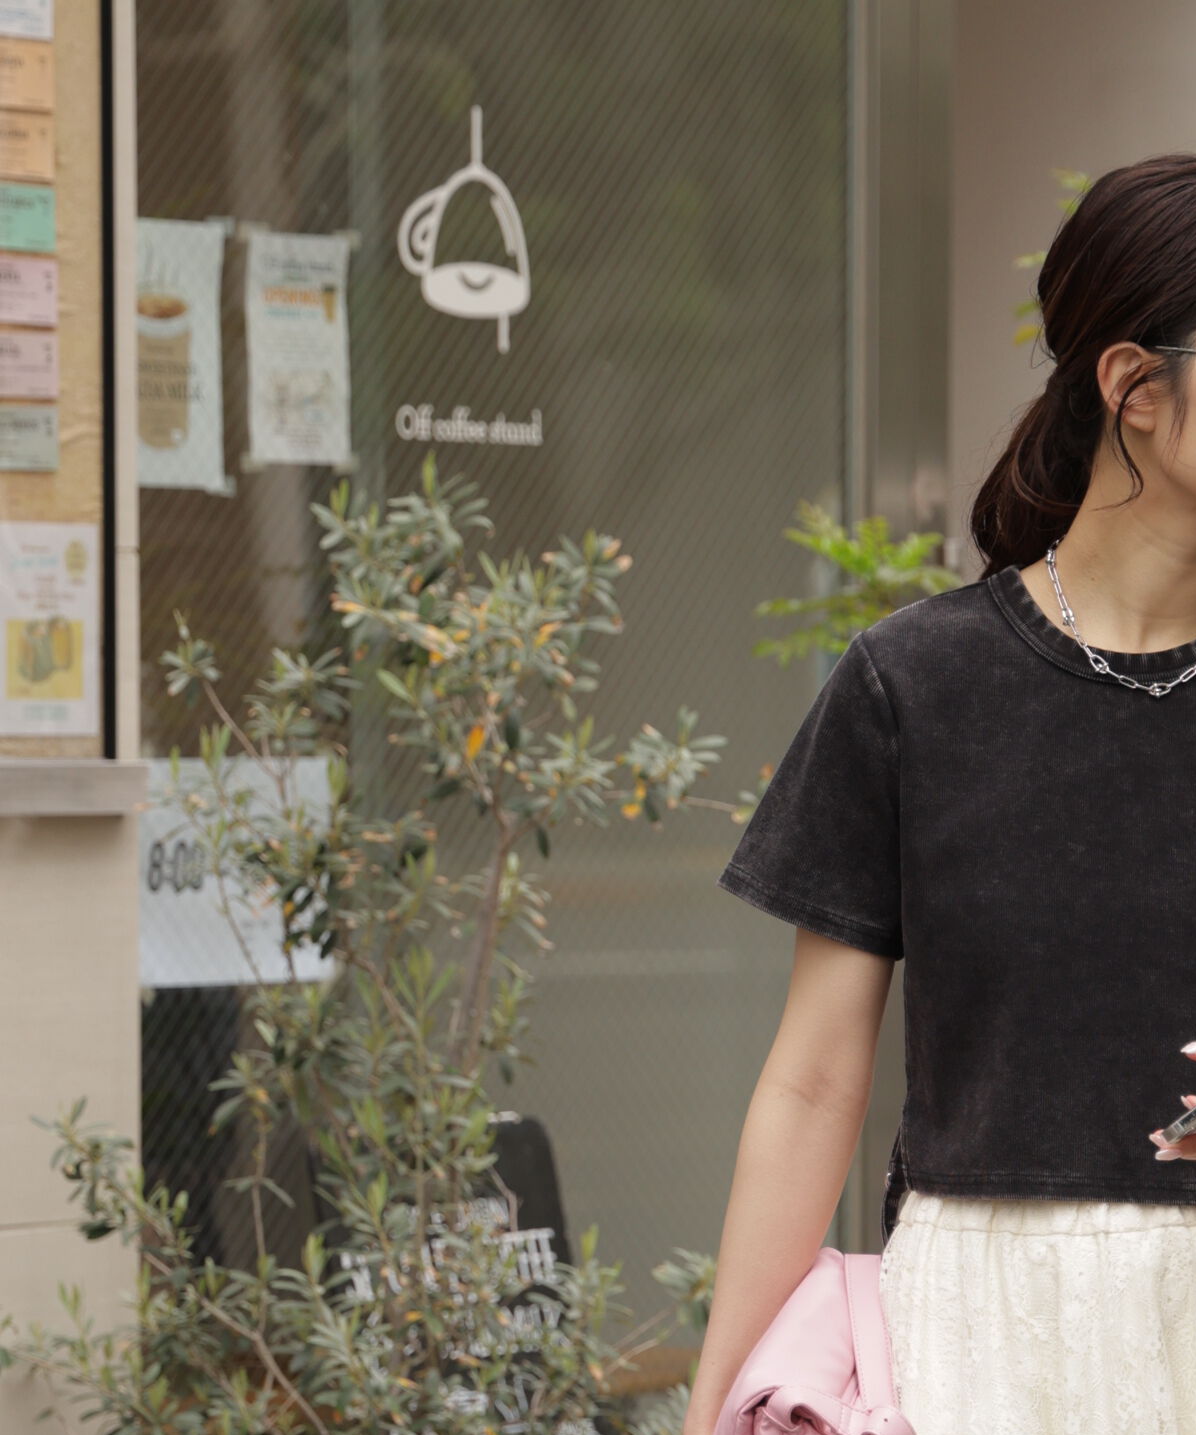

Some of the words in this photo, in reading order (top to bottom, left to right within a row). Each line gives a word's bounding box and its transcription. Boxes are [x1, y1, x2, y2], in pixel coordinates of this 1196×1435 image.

[395, 403, 434, 441] Off
[433, 405, 488, 444] coffee
[489, 407, 544, 446] stand
